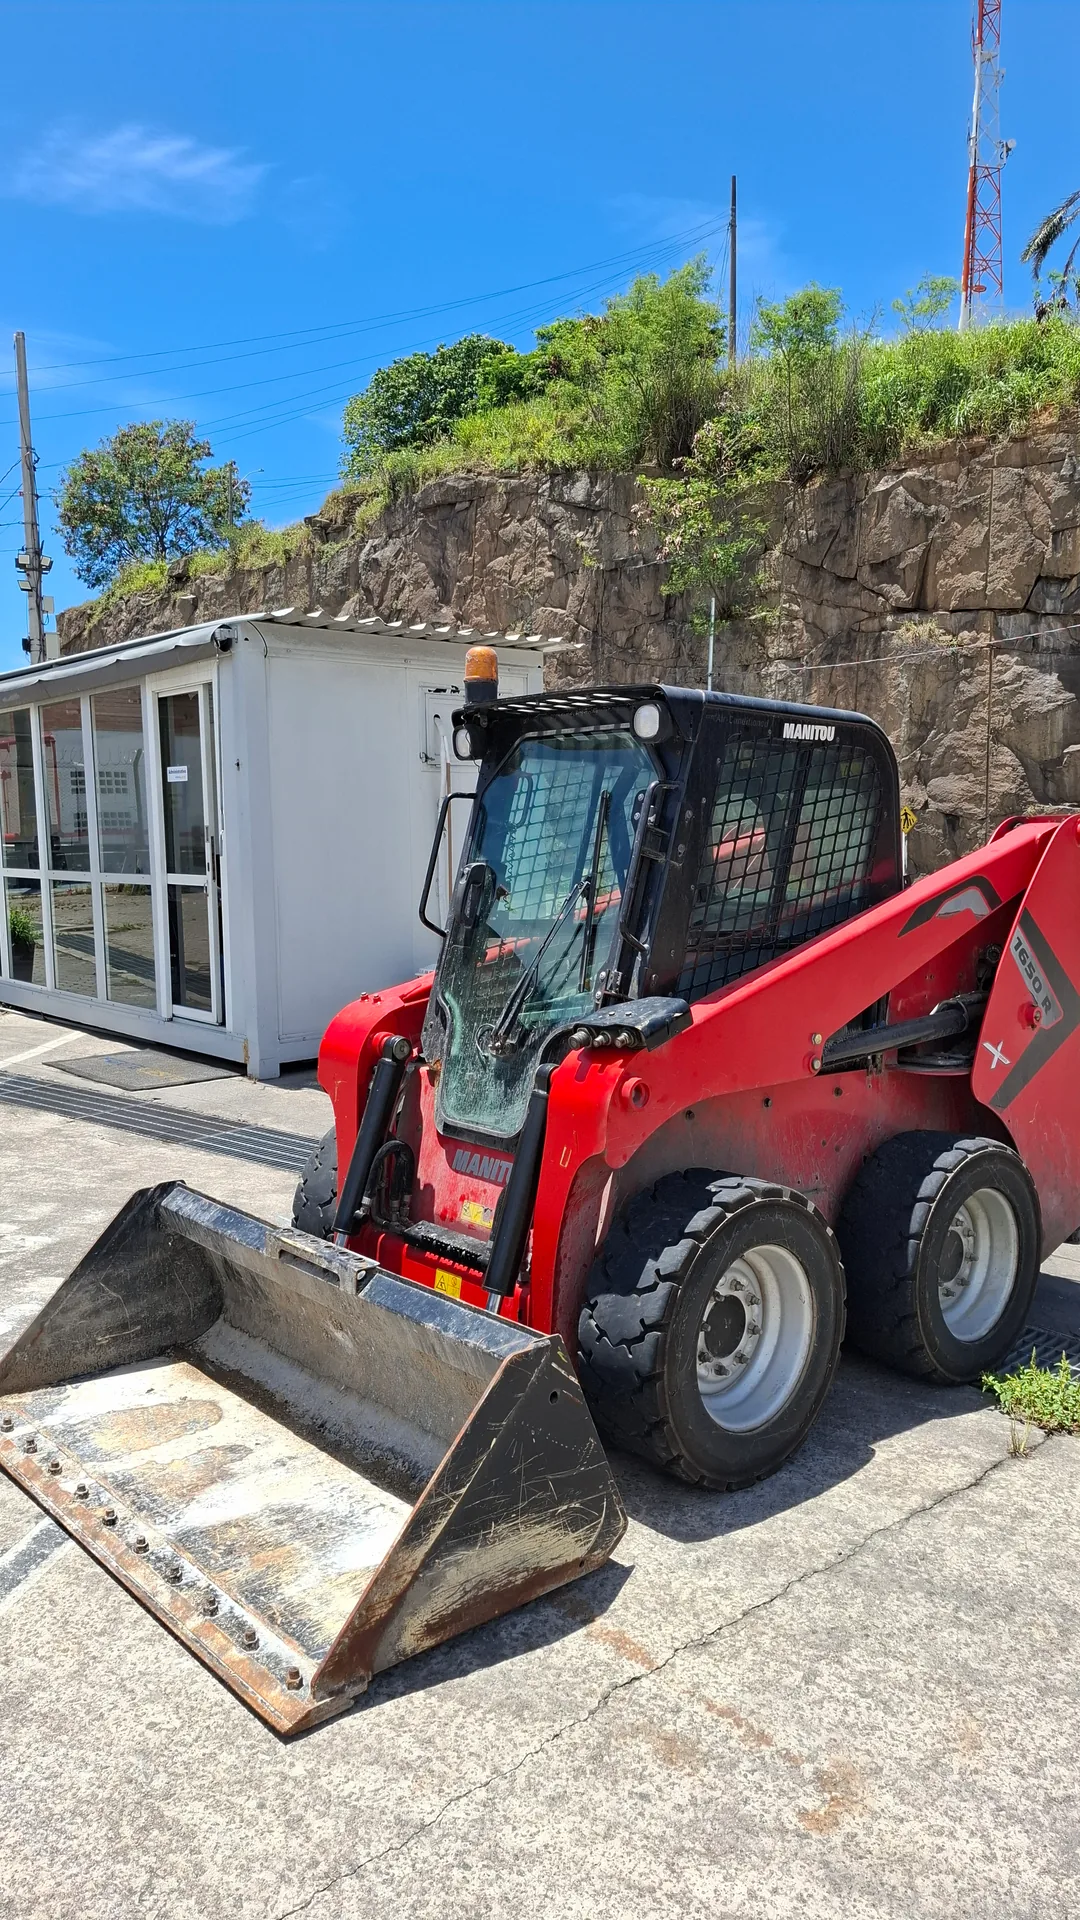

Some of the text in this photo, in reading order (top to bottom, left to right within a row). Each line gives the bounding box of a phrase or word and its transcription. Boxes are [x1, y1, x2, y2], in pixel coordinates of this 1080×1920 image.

[782, 722, 836, 742] MANITOU
[1012, 936, 1053, 1015] 1650 R
[982, 1040, 1011, 1070] X
[452, 1149, 513, 1184] MANIT
